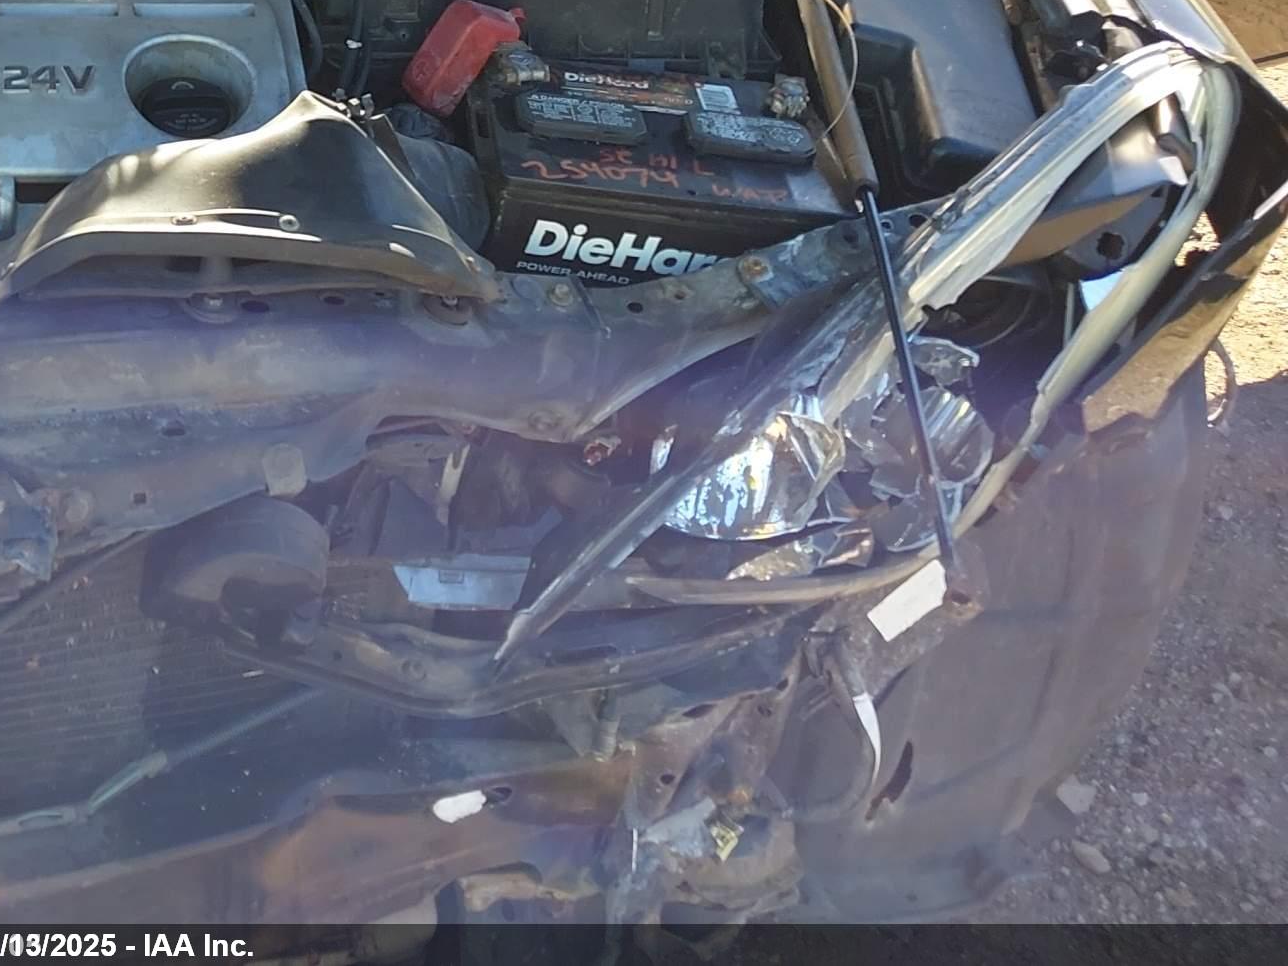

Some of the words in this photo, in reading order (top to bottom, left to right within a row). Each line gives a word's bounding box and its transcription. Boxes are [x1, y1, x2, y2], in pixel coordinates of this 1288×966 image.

[2, 64, 95, 95] 24V
[564, 71, 650, 90] DieHard
[524, 219, 728, 276] DieHar
[516, 260, 573, 276] POWER
[576, 270, 630, 285] AHEAD
